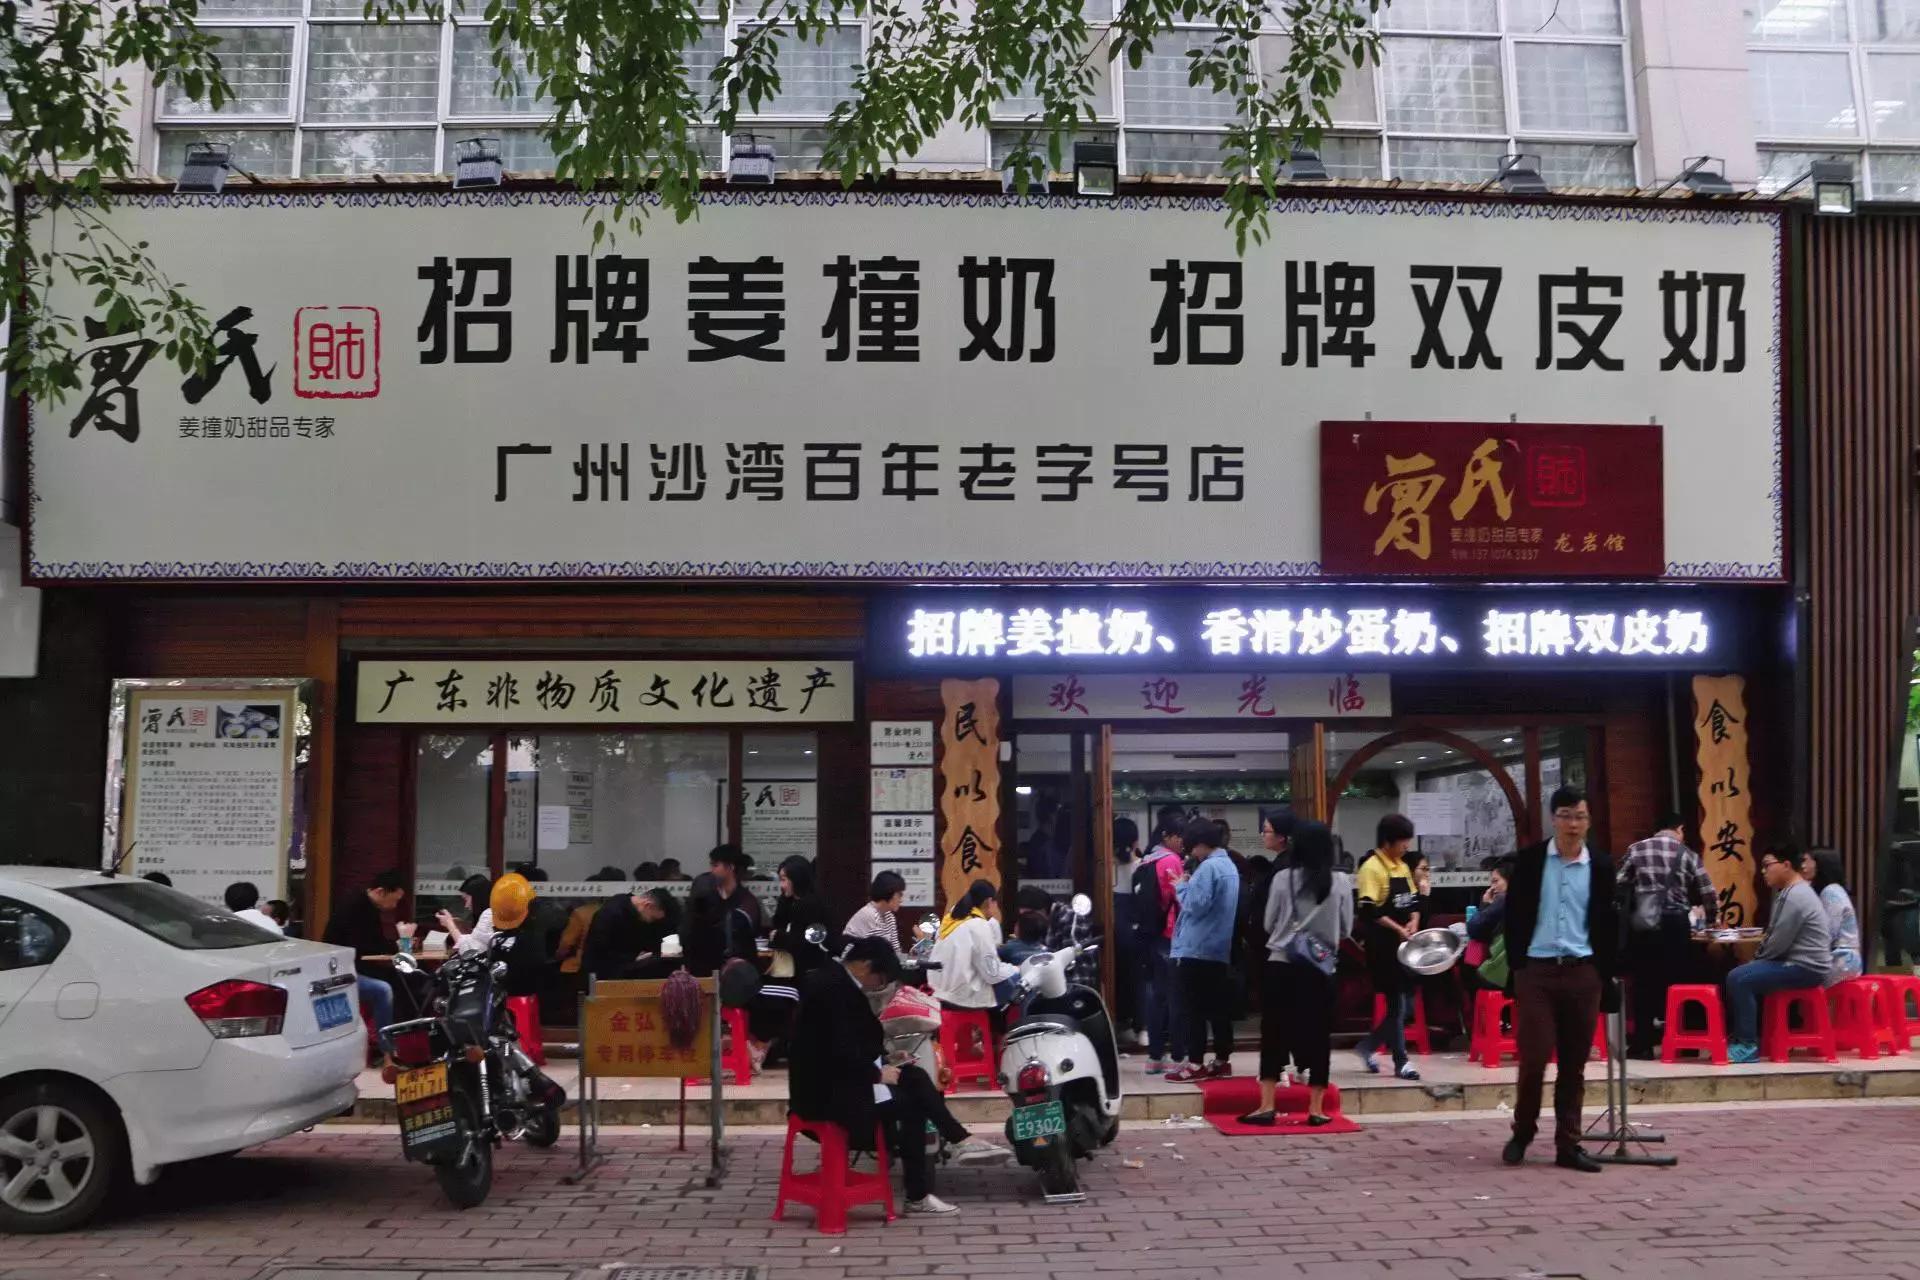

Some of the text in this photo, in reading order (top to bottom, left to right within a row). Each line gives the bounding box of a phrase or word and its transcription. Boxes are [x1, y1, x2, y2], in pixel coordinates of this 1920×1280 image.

[417, 255, 1747, 373] 招牌姜撞奶 招牌双皮奶
[179, 417, 335, 439] 姜撞奶甜品专家
[494, 442, 1244, 502] 广州沙湾百年老字号店
[1554, 532, 1627, 554] 龙岩馆
[908, 608, 1175, 657] 招牌姜撞奶、
[1483, 609, 1708, 656] 招牌双皮奶
[378, 667, 836, 714] 广东非物质文化遗产
[1048, 674, 1365, 716] 欢迎光临
[1016, 1116, 1063, 1138] E9302
